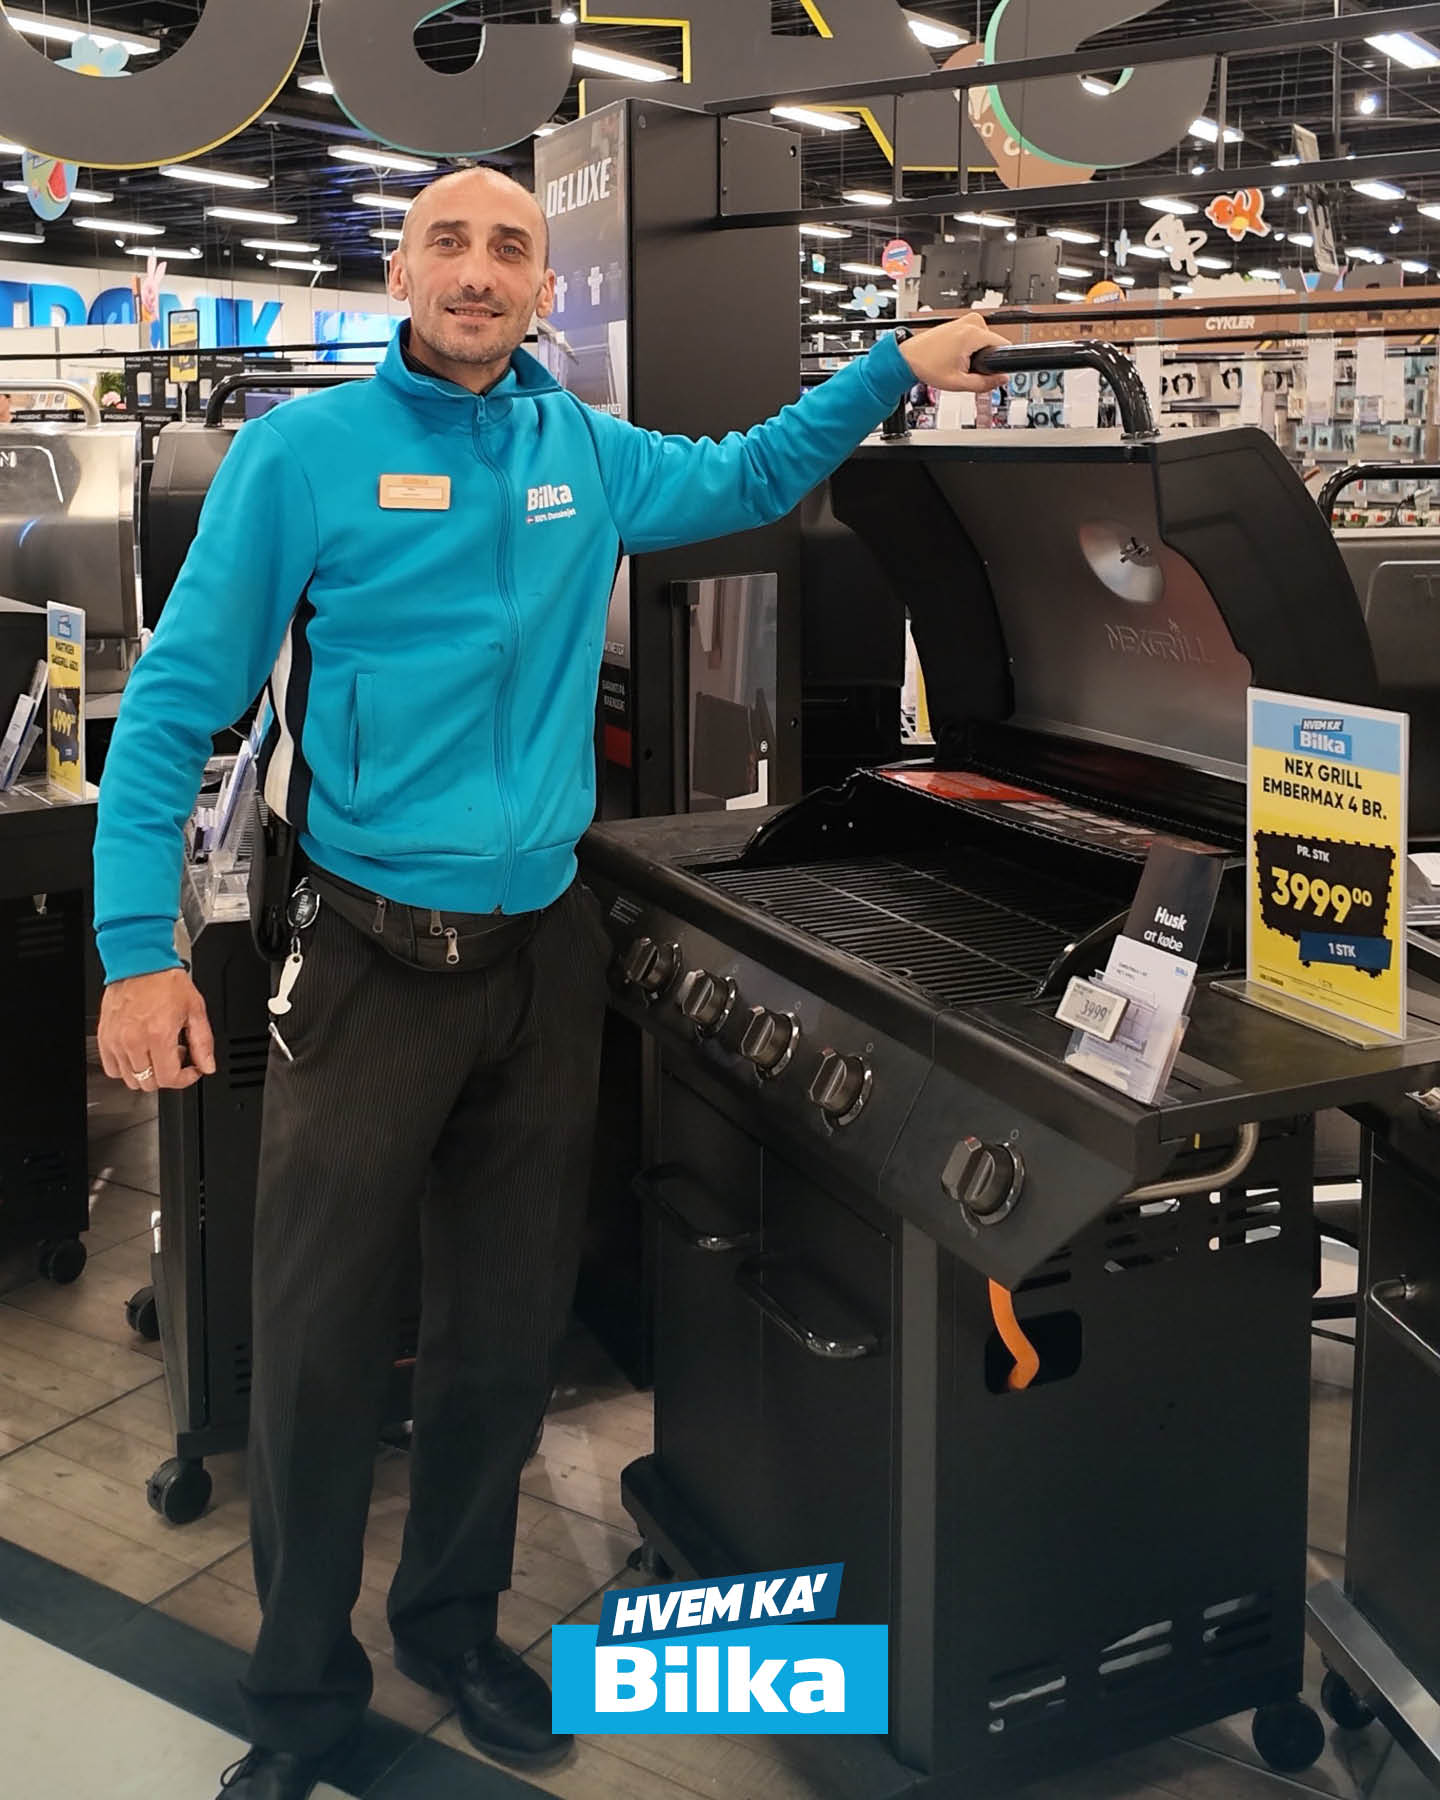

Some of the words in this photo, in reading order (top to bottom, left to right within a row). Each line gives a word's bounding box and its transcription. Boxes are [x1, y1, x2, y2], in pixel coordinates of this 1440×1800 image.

[546, 157, 612, 218] DELUXE
[1205, 315, 1256, 331] CYKLER
[527, 484, 573, 511] Bilka
[1300, 731, 1346, 754] Bilka
[1285, 757, 1313, 779] NEX
[1318, 765, 1362, 789] GRILL
[1263, 776, 1344, 809] EMBERMAX
[1348, 796, 1358, 813] 4
[1362, 799, 1387, 820] BR.
[1297, 845, 1311, 858] PR.
[1312, 850, 1330, 863] STK
[1154, 906, 1187, 931] Husk
[1144, 930, 1155, 943] at
[1157, 932, 1184, 952] købe
[1328, 942, 1335, 955] 1
[1336, 944, 1356, 958] STK
